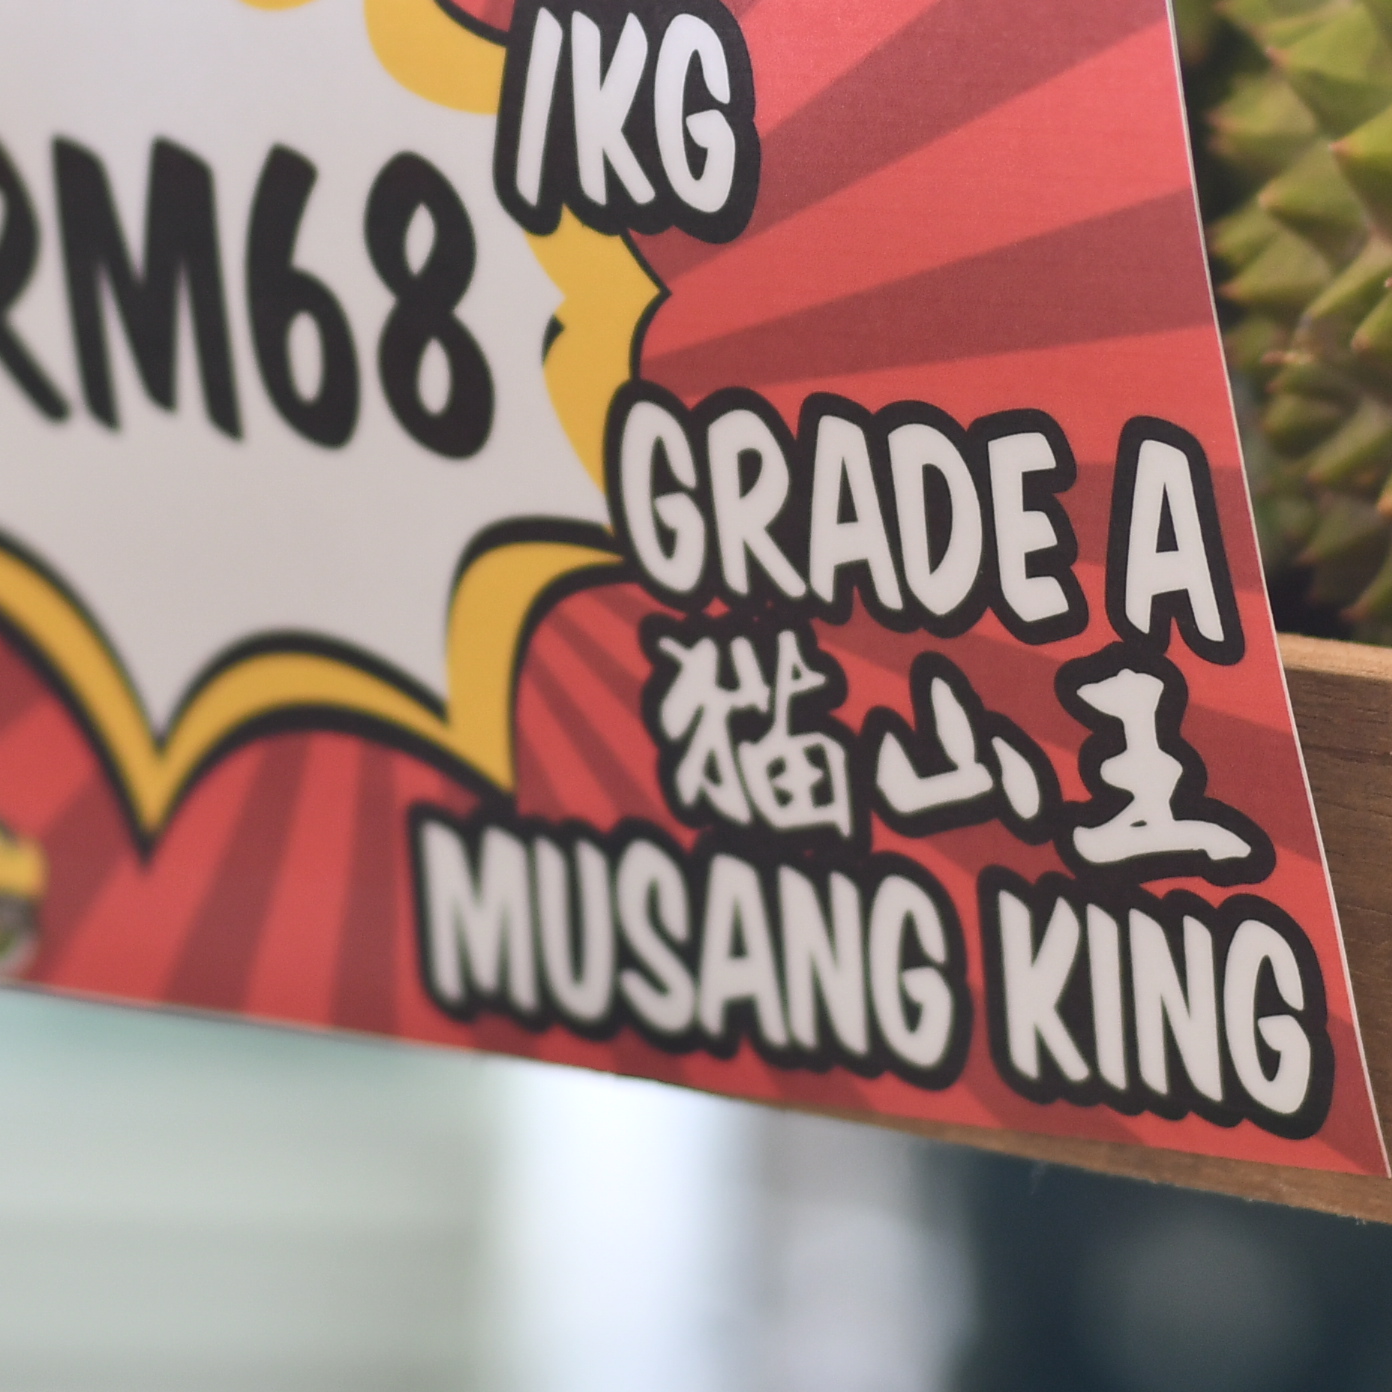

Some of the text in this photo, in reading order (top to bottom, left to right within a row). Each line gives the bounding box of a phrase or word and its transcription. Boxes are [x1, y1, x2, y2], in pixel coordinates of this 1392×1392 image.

[513, 4, 737, 215] /KG
[620, 400, 1226, 645] GRADE A
[658, 628, 1253, 864] 猫山王
[420, 818, 1313, 1116] MUSANG KING
